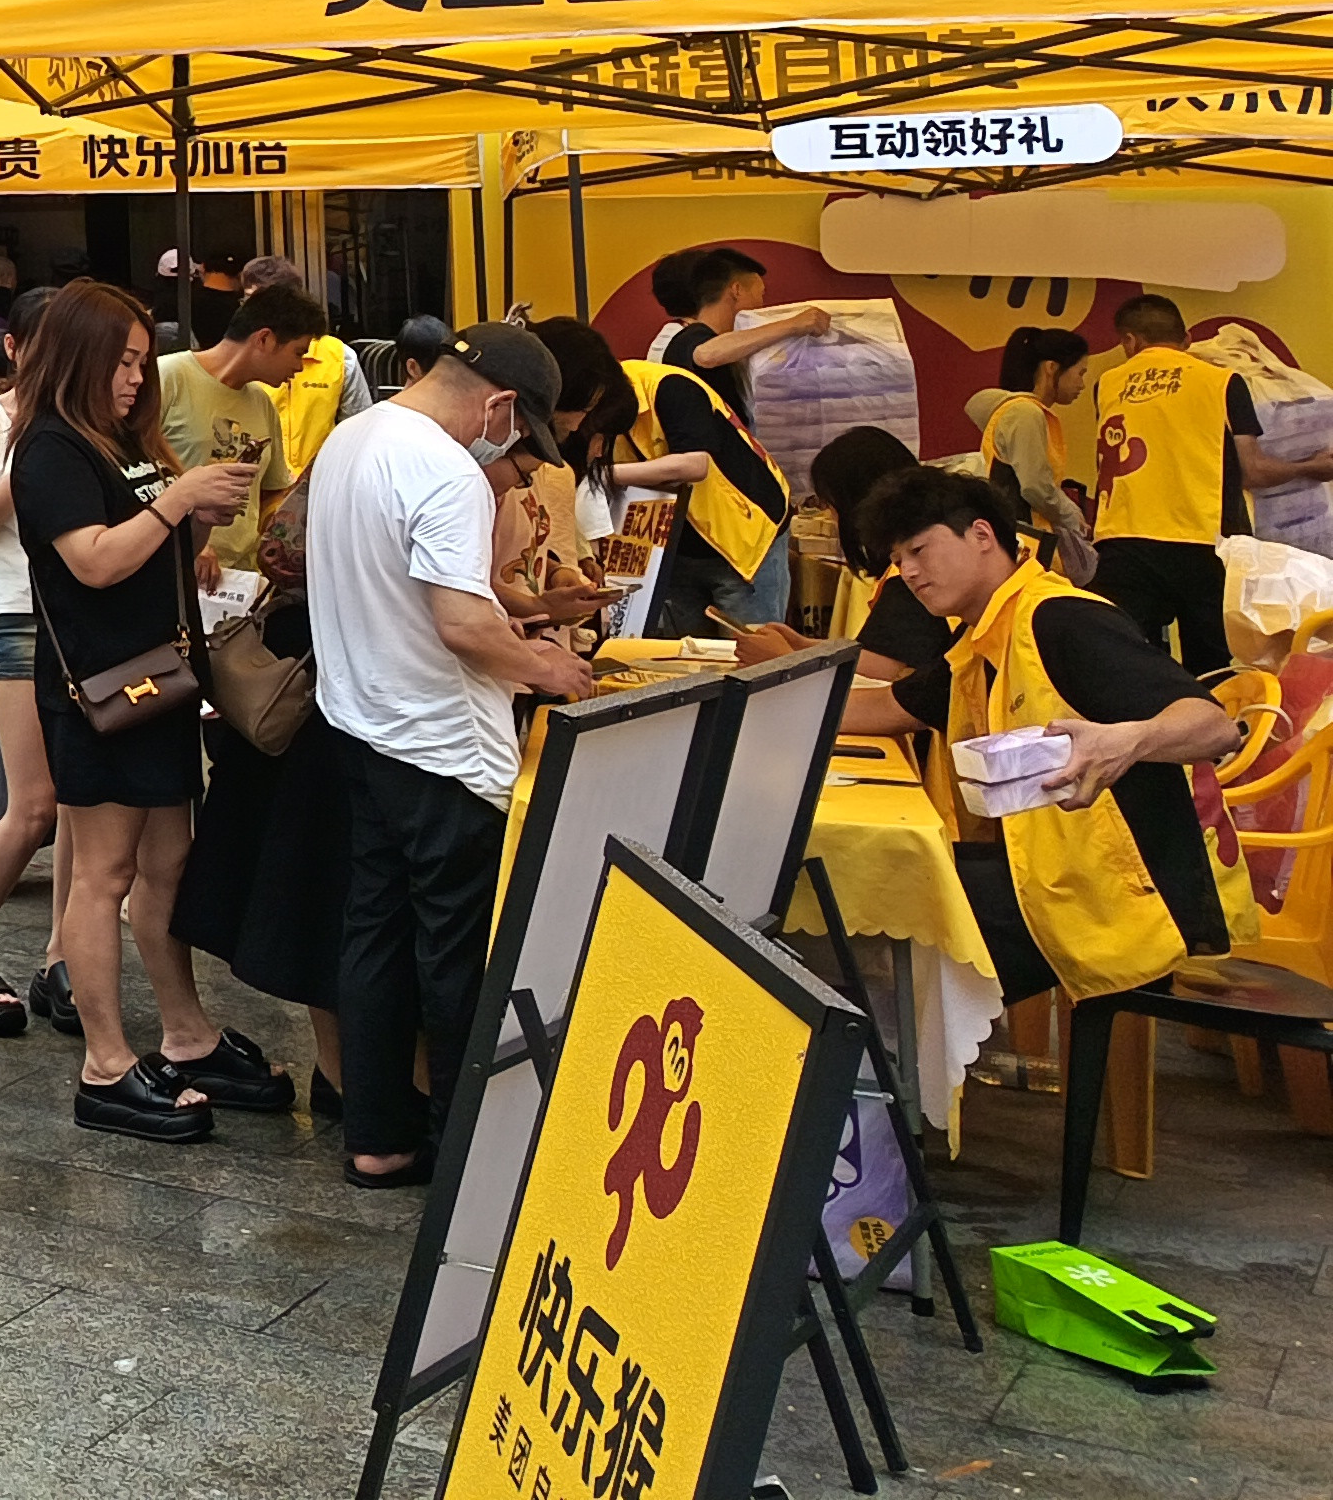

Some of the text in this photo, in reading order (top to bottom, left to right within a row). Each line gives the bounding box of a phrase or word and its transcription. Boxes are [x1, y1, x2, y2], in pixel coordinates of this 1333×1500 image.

[828, 115, 1065, 161] 互动领好礼
[518, 1238, 666, 1500] 快乐猴
